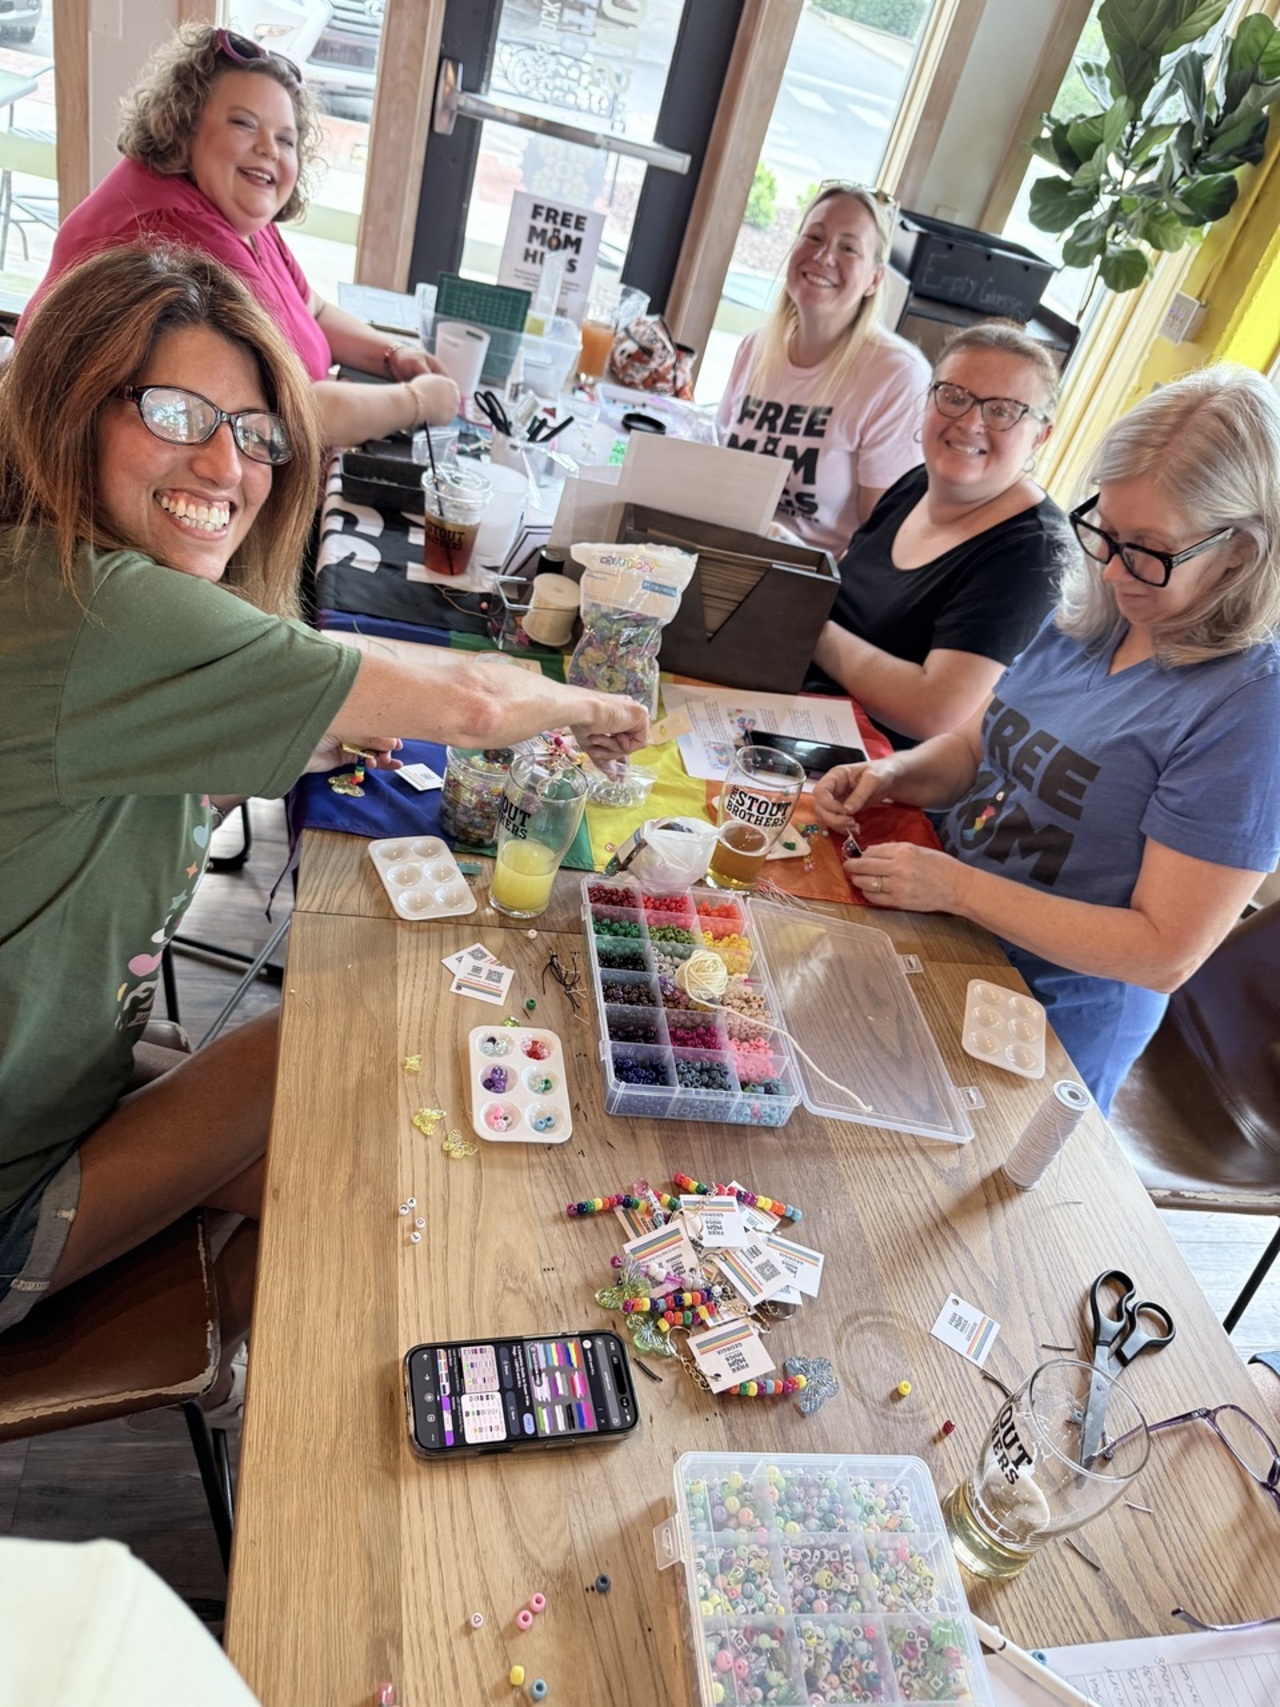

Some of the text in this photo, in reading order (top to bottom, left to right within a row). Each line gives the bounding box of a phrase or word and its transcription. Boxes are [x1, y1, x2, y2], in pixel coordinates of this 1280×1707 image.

[531, 203, 587, 232] FREE
[523, 247, 577, 273] HS
[736, 394, 833, 438] FREE
[502, 796, 531, 828] OUT
[726, 800, 786, 828] BROTHERS
[736, 791, 791, 817] STOUT
[999, 1405, 1033, 1470] OUT
[991, 1421, 1019, 1485] HERS
